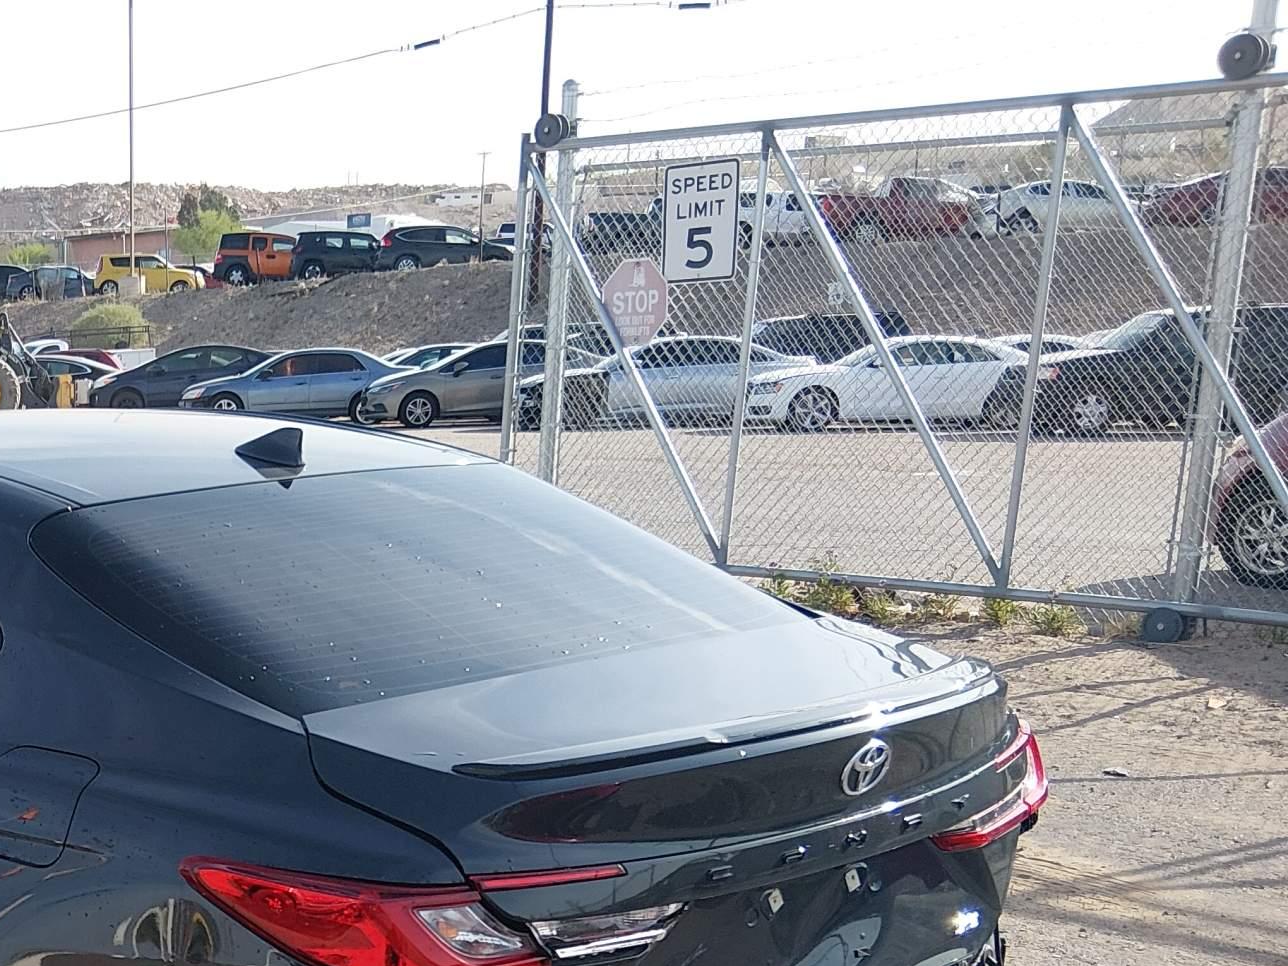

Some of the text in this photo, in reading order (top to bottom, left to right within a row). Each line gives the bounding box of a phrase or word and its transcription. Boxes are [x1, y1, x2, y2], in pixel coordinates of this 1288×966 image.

[671, 172, 733, 195] SPEED
[676, 199, 726, 220] LIMIT
[684, 226, 714, 269] 5
[612, 289, 659, 315] STOP
